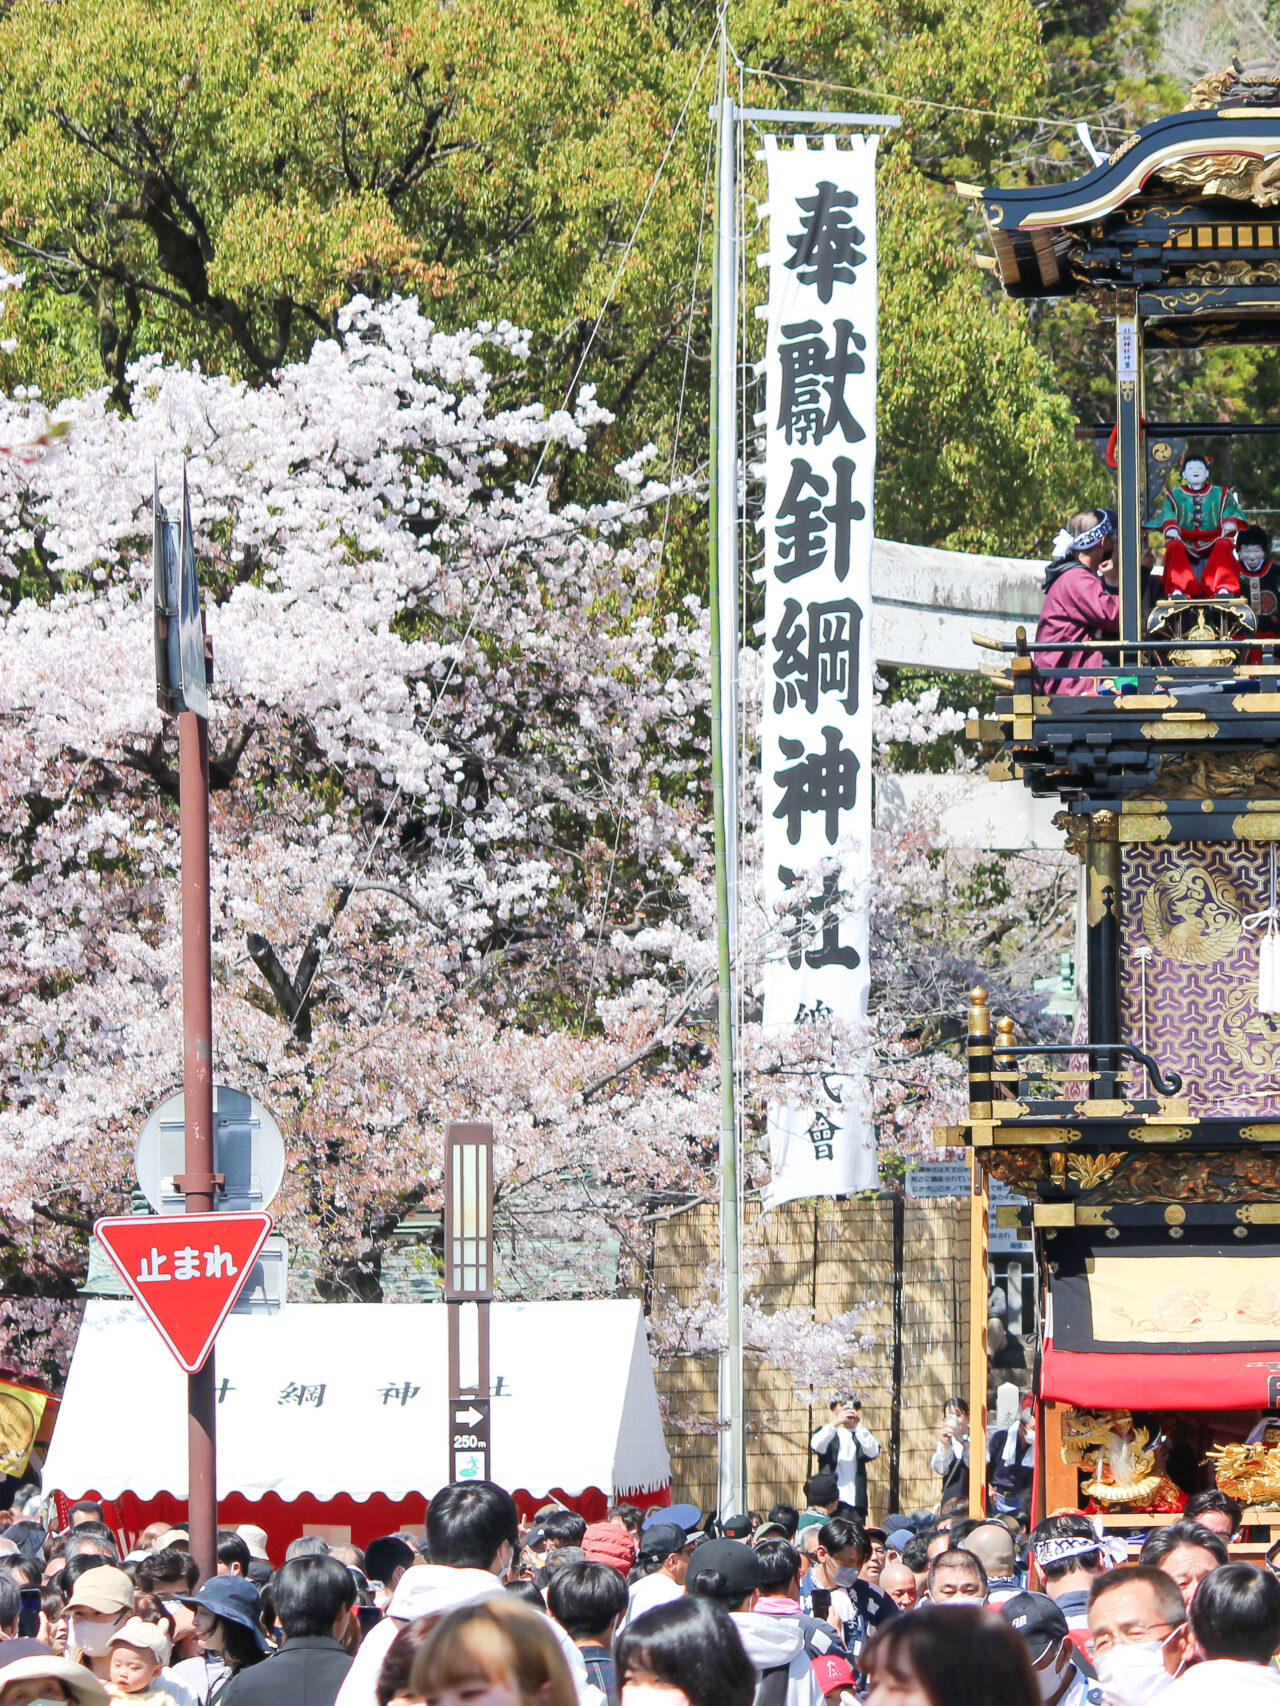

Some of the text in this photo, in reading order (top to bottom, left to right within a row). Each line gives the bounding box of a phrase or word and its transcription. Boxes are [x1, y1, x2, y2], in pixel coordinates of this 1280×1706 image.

[136, 1244, 238, 1282] 止まれ
[453, 1435, 487, 1448] 250m
